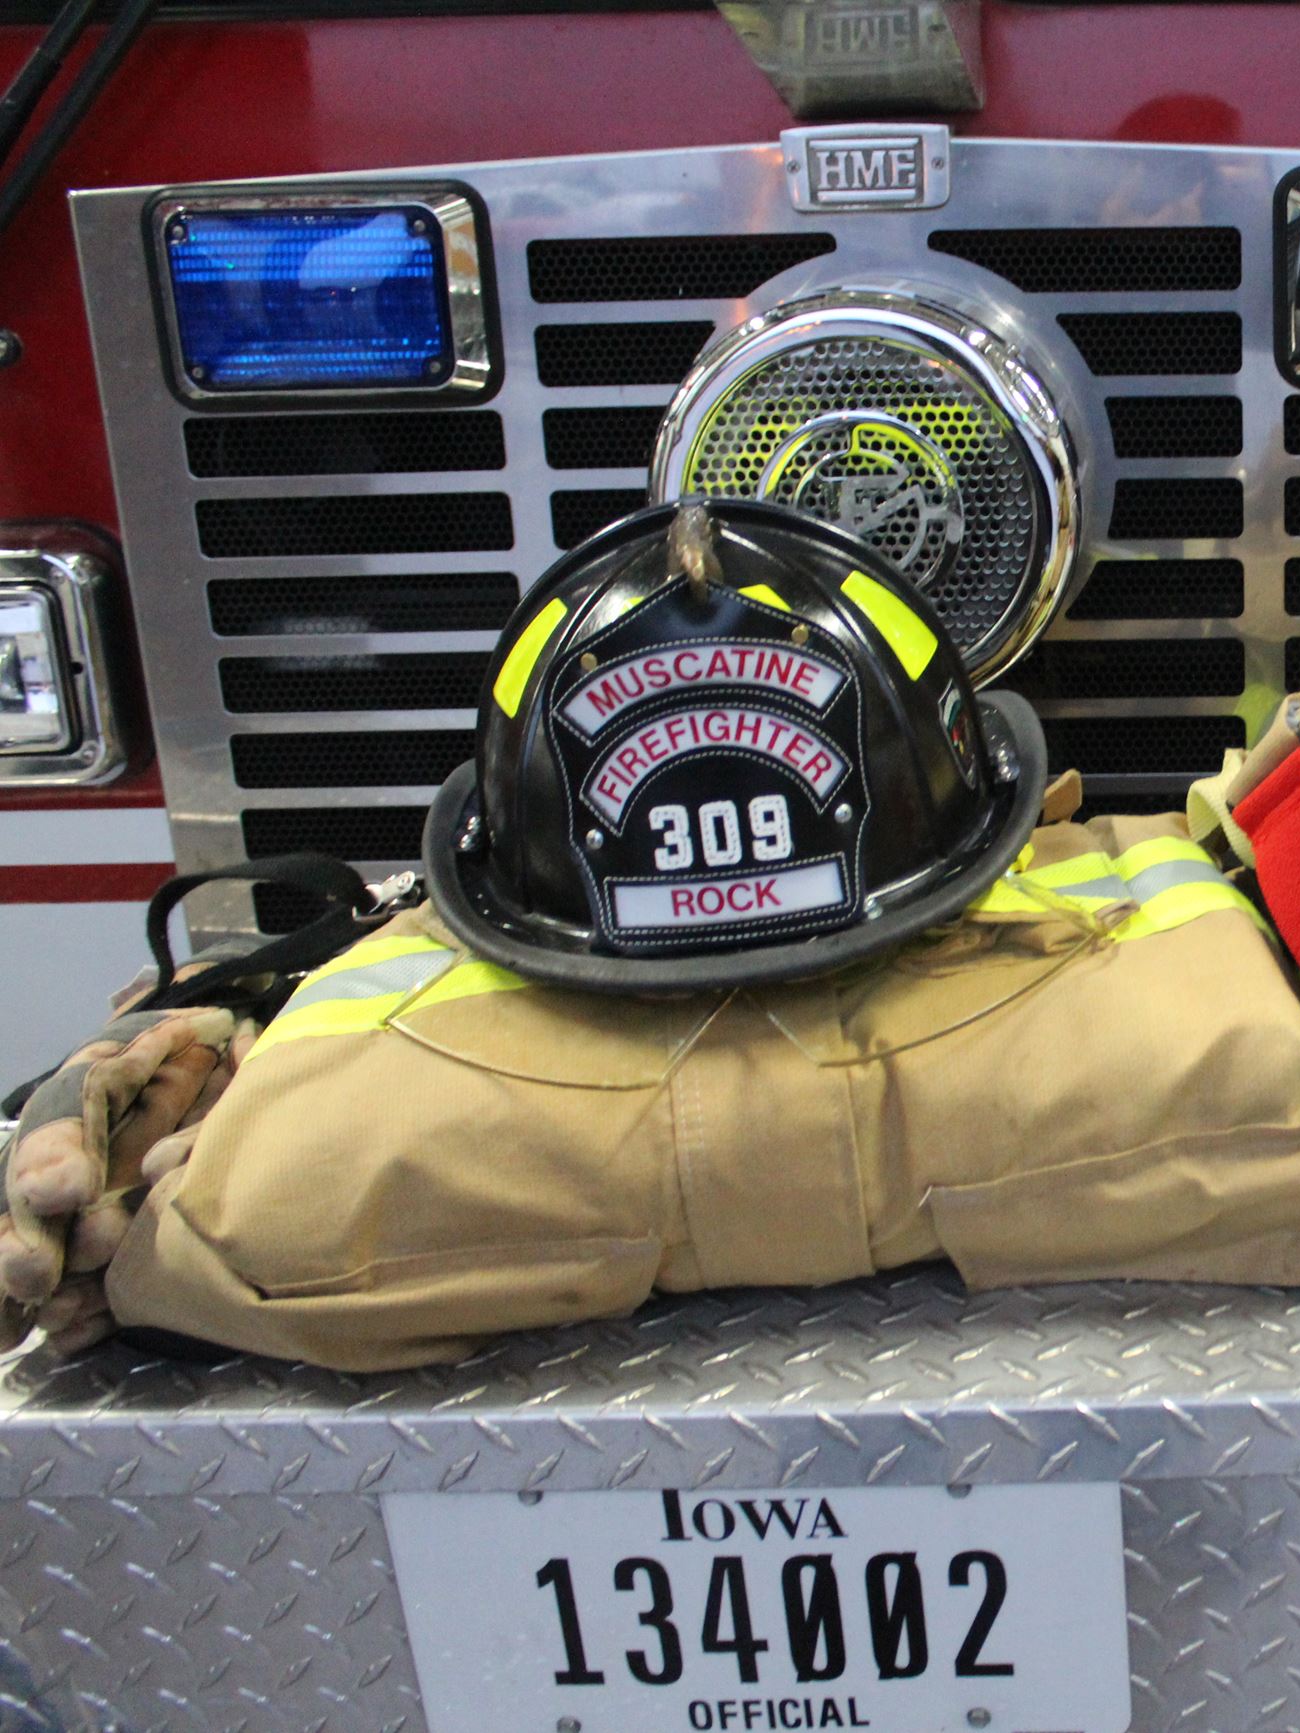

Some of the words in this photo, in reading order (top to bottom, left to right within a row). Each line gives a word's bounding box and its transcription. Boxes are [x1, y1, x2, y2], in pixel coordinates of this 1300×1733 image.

[816, 149, 917, 189] HME
[586, 647, 821, 717] MUSCATINE
[597, 711, 832, 804] FIREFIGHTER
[648, 794, 793, 872] 309
[671, 879, 781, 917] ROCK
[660, 1488, 849, 1542] IOWA
[536, 1550, 1015, 1686] 134002
[687, 1697, 870, 1730] OFFICIAL
